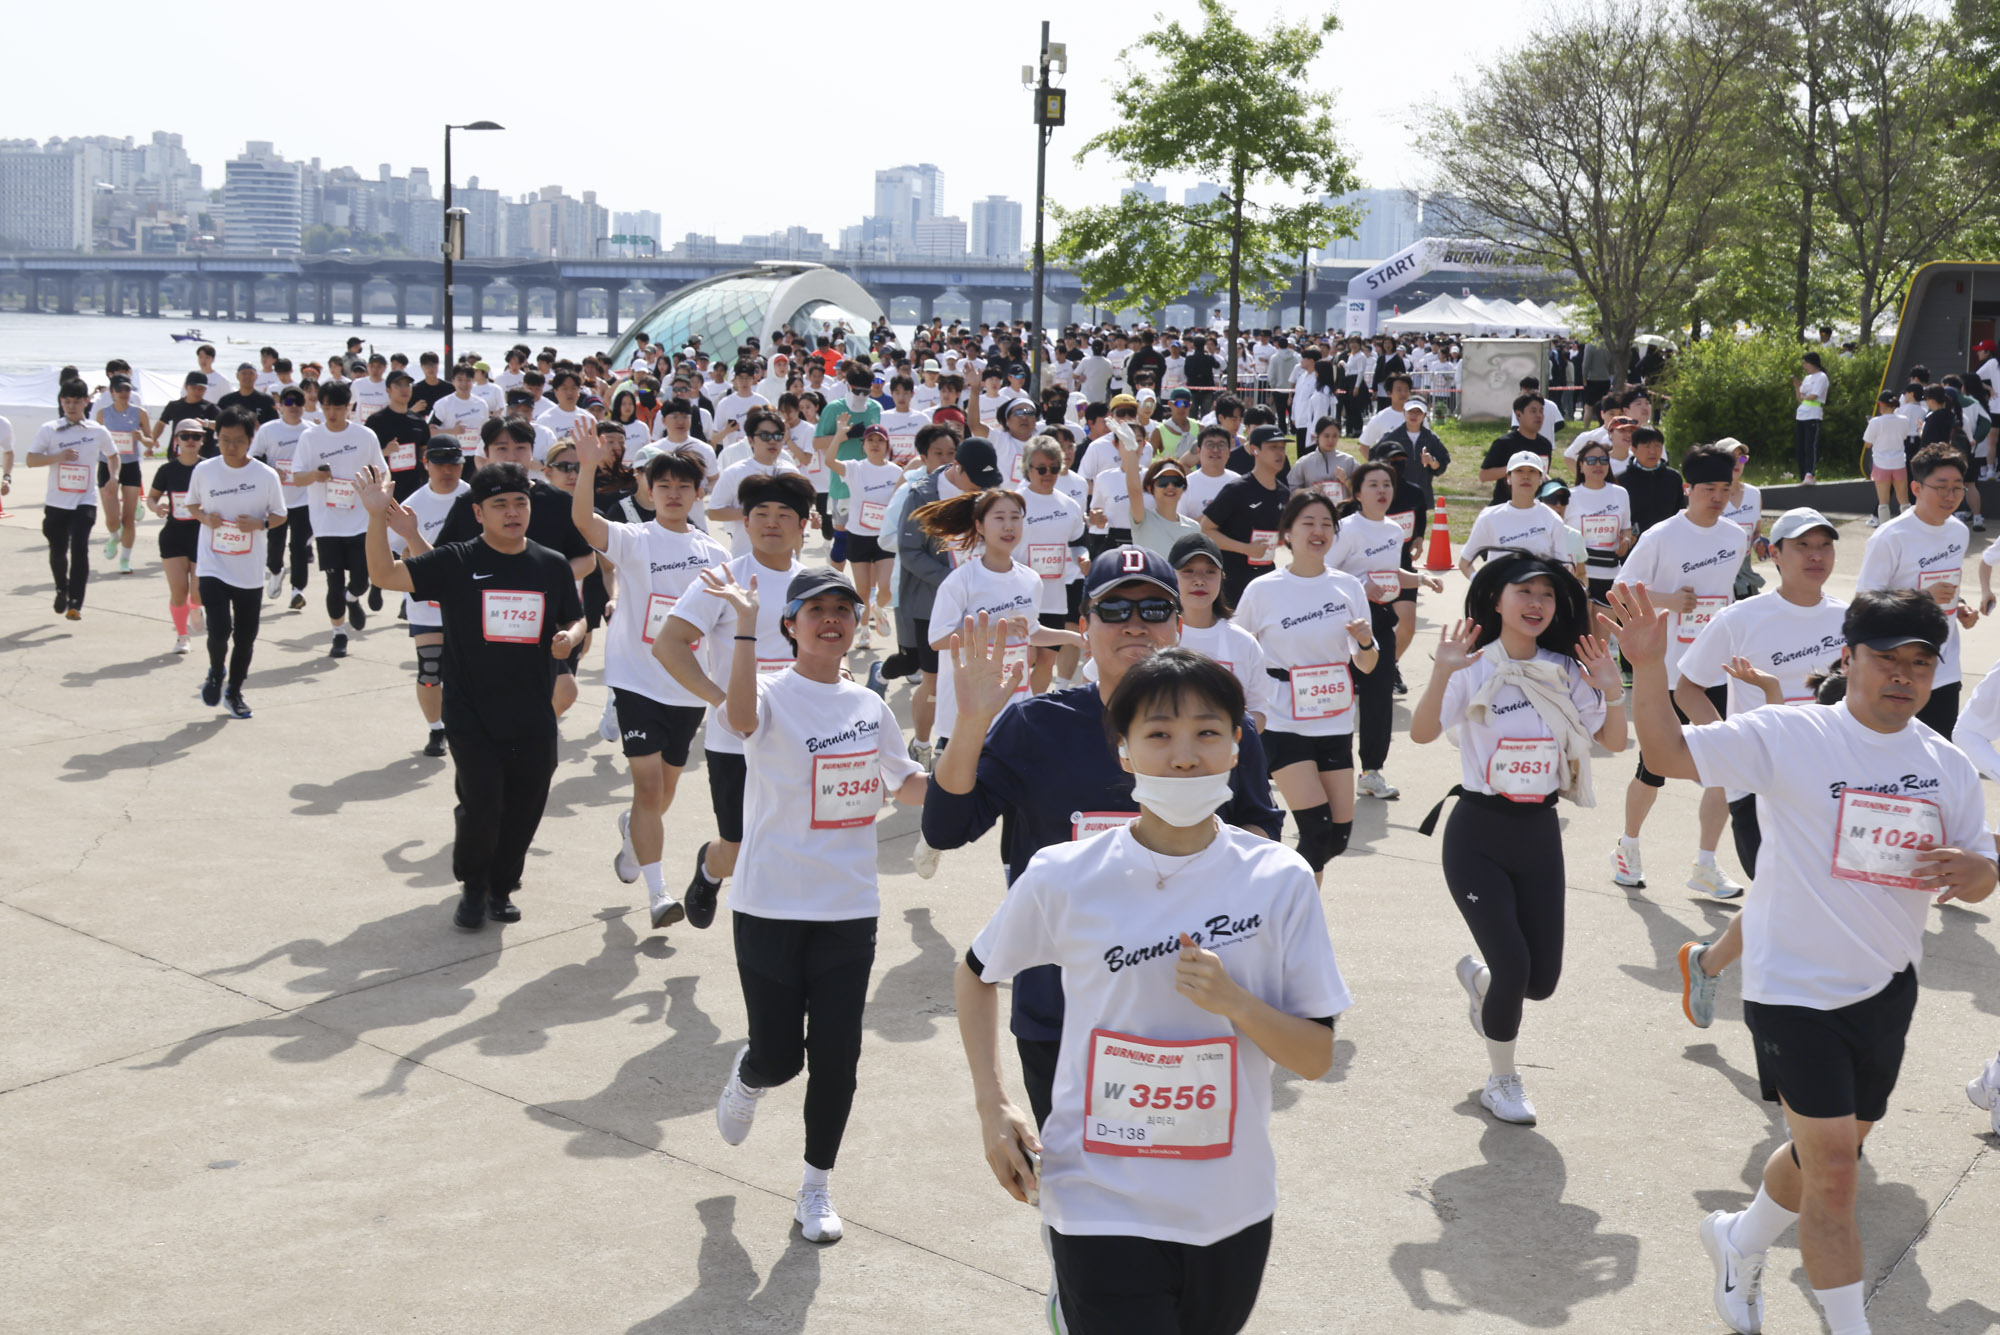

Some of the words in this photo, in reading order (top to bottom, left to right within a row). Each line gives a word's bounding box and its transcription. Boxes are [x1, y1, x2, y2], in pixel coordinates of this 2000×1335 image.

[1366, 253, 1416, 290] START
[222, 532, 246, 542] 2261
[650, 562, 687, 574] Burning
[687, 556, 709, 566] Run
[1122, 550, 1144, 573] D
[1682, 556, 1718, 573] Burning
[1717, 550, 1736, 560] Run
[1918, 551, 1948, 568] Burning
[1948, 544, 1962, 553] Run
[1014, 596, 1032, 605] Run
[490, 610, 500, 618] M
[502, 610, 536, 622] 1742
[1281, 610, 1324, 630] Burning
[1323, 602, 1346, 614] Run
[1695, 614, 1711, 624] 24
[1771, 644, 1820, 666] Burning
[1821, 636, 1848, 651] Run
[1310, 682, 1346, 697] 3465
[806, 730, 857, 753] Burning
[854, 720, 880, 735] Run
[822, 761, 852, 770] BURNING
[853, 760, 866, 768] RUN
[1496, 762, 1507, 771] W
[1508, 761, 1551, 774] 3631
[822, 784, 834, 795] W
[836, 778, 880, 797] 3349
[1900, 774, 1939, 793] Run
[1850, 799, 1892, 812] BURNING
[1892, 805, 1912, 814] RUN
[1850, 826, 1866, 839] M
[1204, 914, 1262, 942] Run
[1104, 1045, 1154, 1063] BURNING
[1157, 1054, 1184, 1065] RUN
[1196, 1053, 1224, 1062] 10km
[1104, 1082, 1126, 1100] W
[1129, 1084, 1217, 1110] 3556
[1096, 1123, 1146, 1140] D-138
